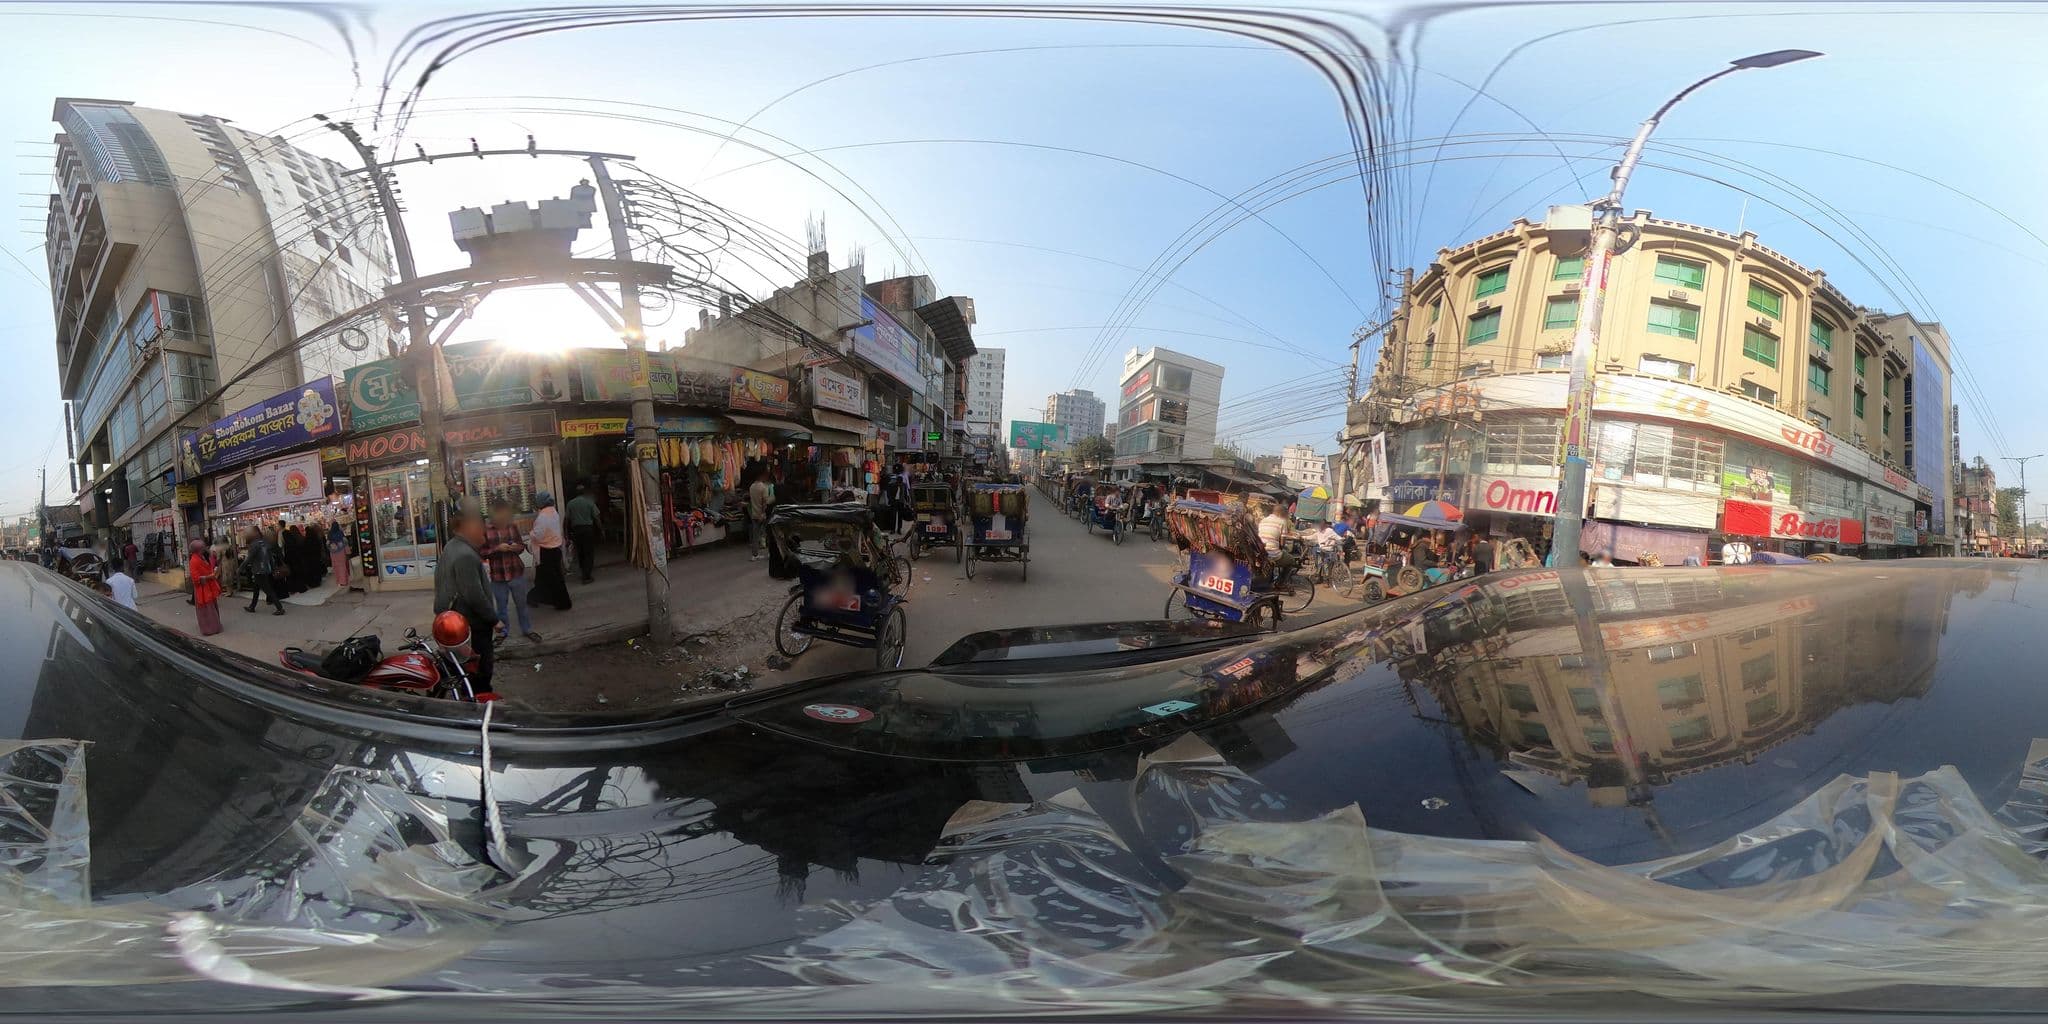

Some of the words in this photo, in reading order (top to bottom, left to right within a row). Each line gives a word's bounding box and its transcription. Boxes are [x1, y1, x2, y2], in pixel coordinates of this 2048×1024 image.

[265, 401, 295, 418] Bazar
[258, 413, 295, 434] বাজার
[350, 431, 427, 461] MOON
[444, 425, 497, 443] PTICAL
[1393, 480, 1428, 500] পালিকা
[1774, 512, 1839, 539] Bata
